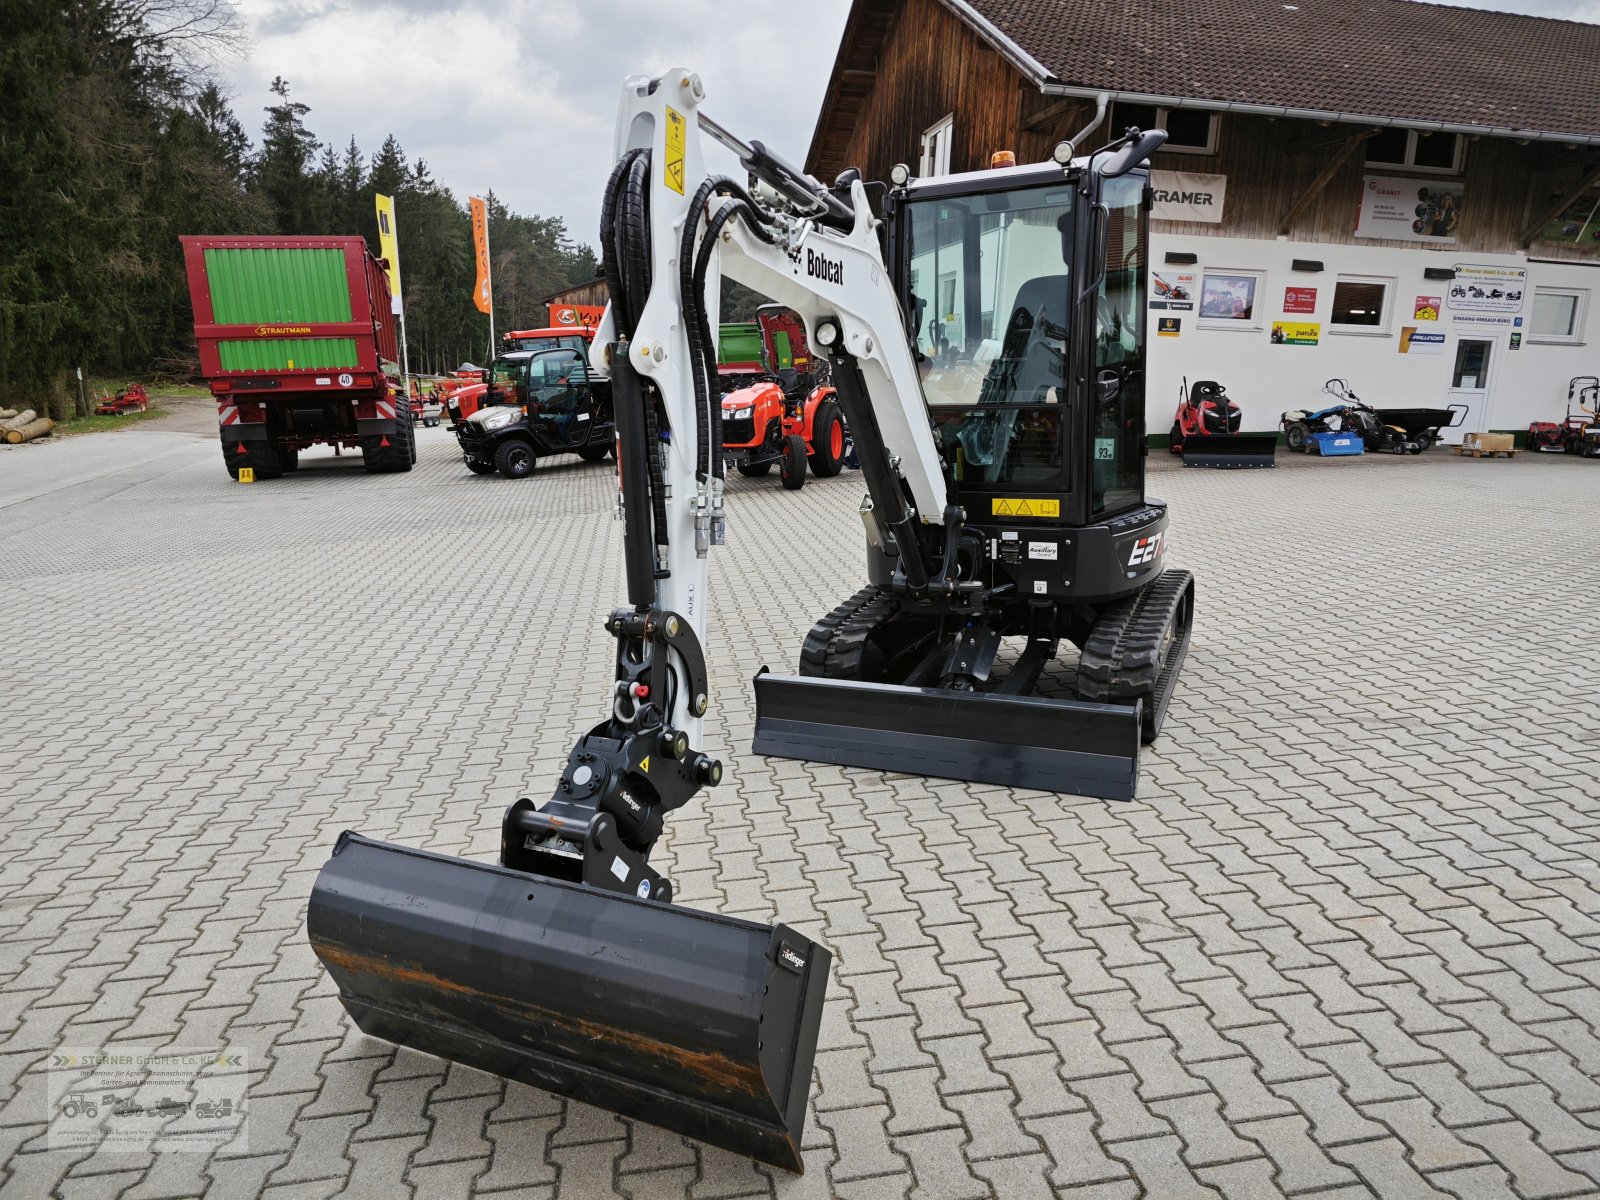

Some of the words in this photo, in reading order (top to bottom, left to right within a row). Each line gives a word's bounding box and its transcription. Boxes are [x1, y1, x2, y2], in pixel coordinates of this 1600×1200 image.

[1153, 190, 1213, 206] KRAMER
[807, 247, 844, 286] Bobcat
[260, 327, 311, 335] STRAUTMANN
[340, 376, 350, 384] 40
[1099, 448, 1108, 458] 93
